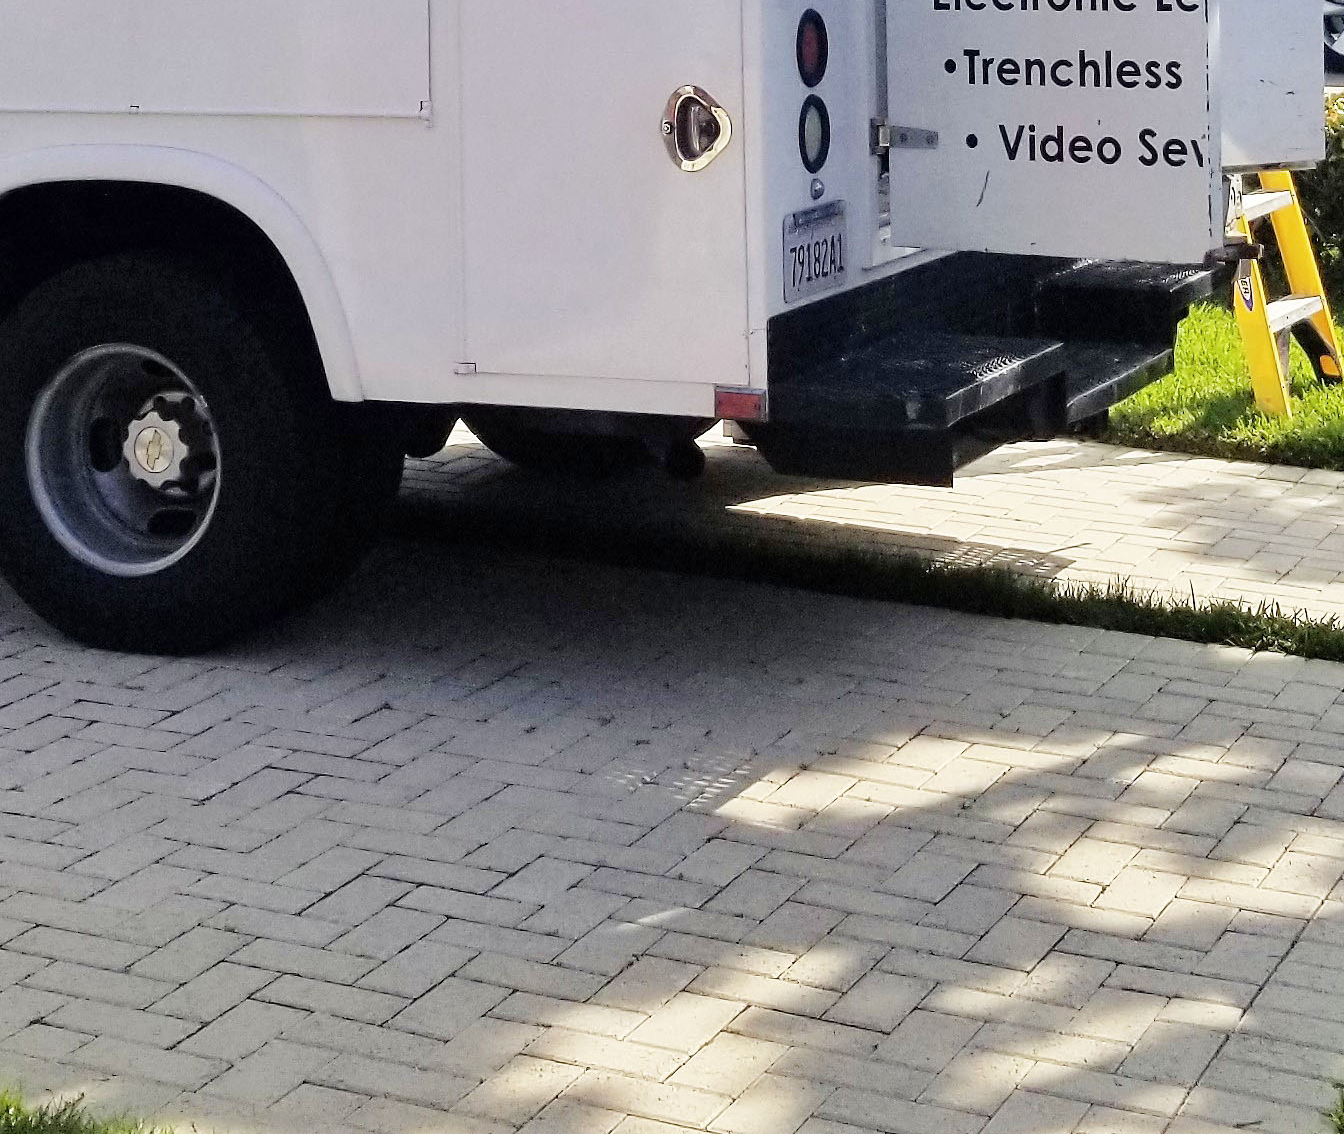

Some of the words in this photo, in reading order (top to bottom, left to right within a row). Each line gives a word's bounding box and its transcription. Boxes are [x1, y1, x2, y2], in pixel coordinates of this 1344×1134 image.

[963, 49, 1183, 90] Trenchless
[998, 124, 1122, 166] Video
[1138, 127, 1204, 168] Se
[789, 233, 844, 288] 79182A1
